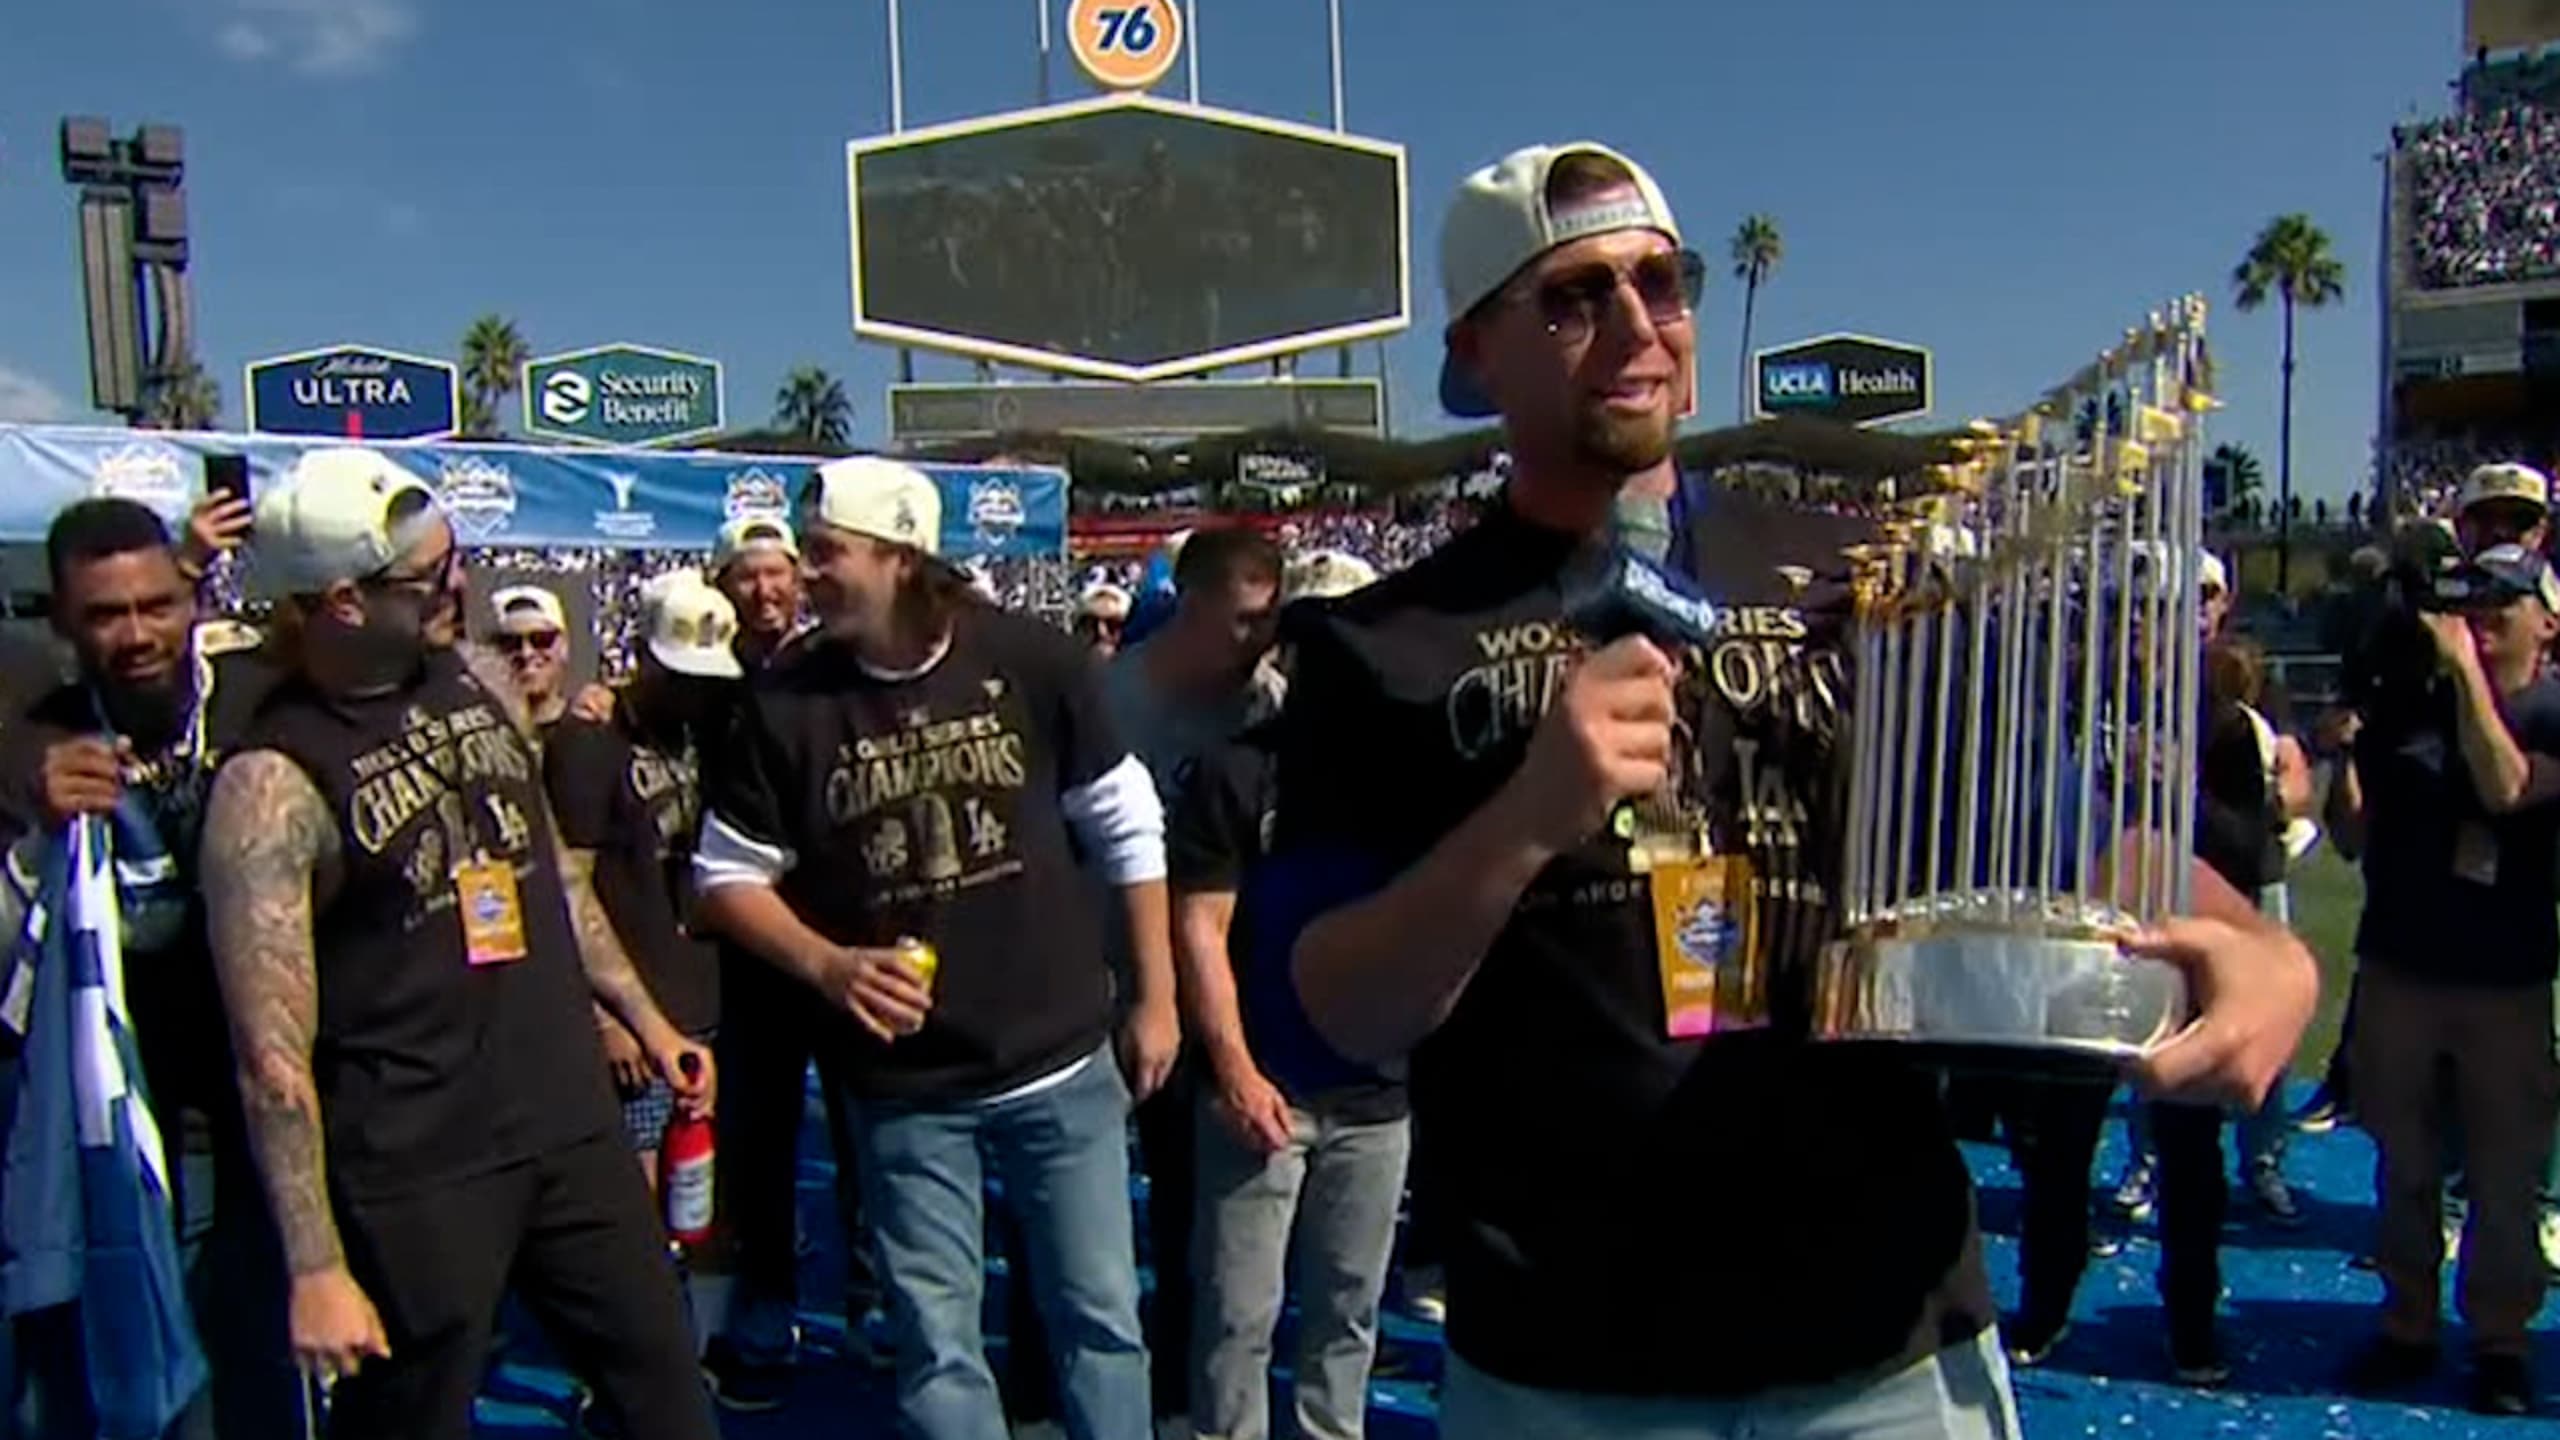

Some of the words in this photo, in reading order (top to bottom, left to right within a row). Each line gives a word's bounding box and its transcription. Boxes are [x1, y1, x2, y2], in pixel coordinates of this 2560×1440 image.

[1097, 5, 1156, 51] 76
[293, 378, 411, 405] ULTRA
[599, 369, 699, 396] Security
[1768, 368, 1825, 395] UCLA
[1839, 368, 1916, 394] Health
[602, 398, 689, 424] Benefit
